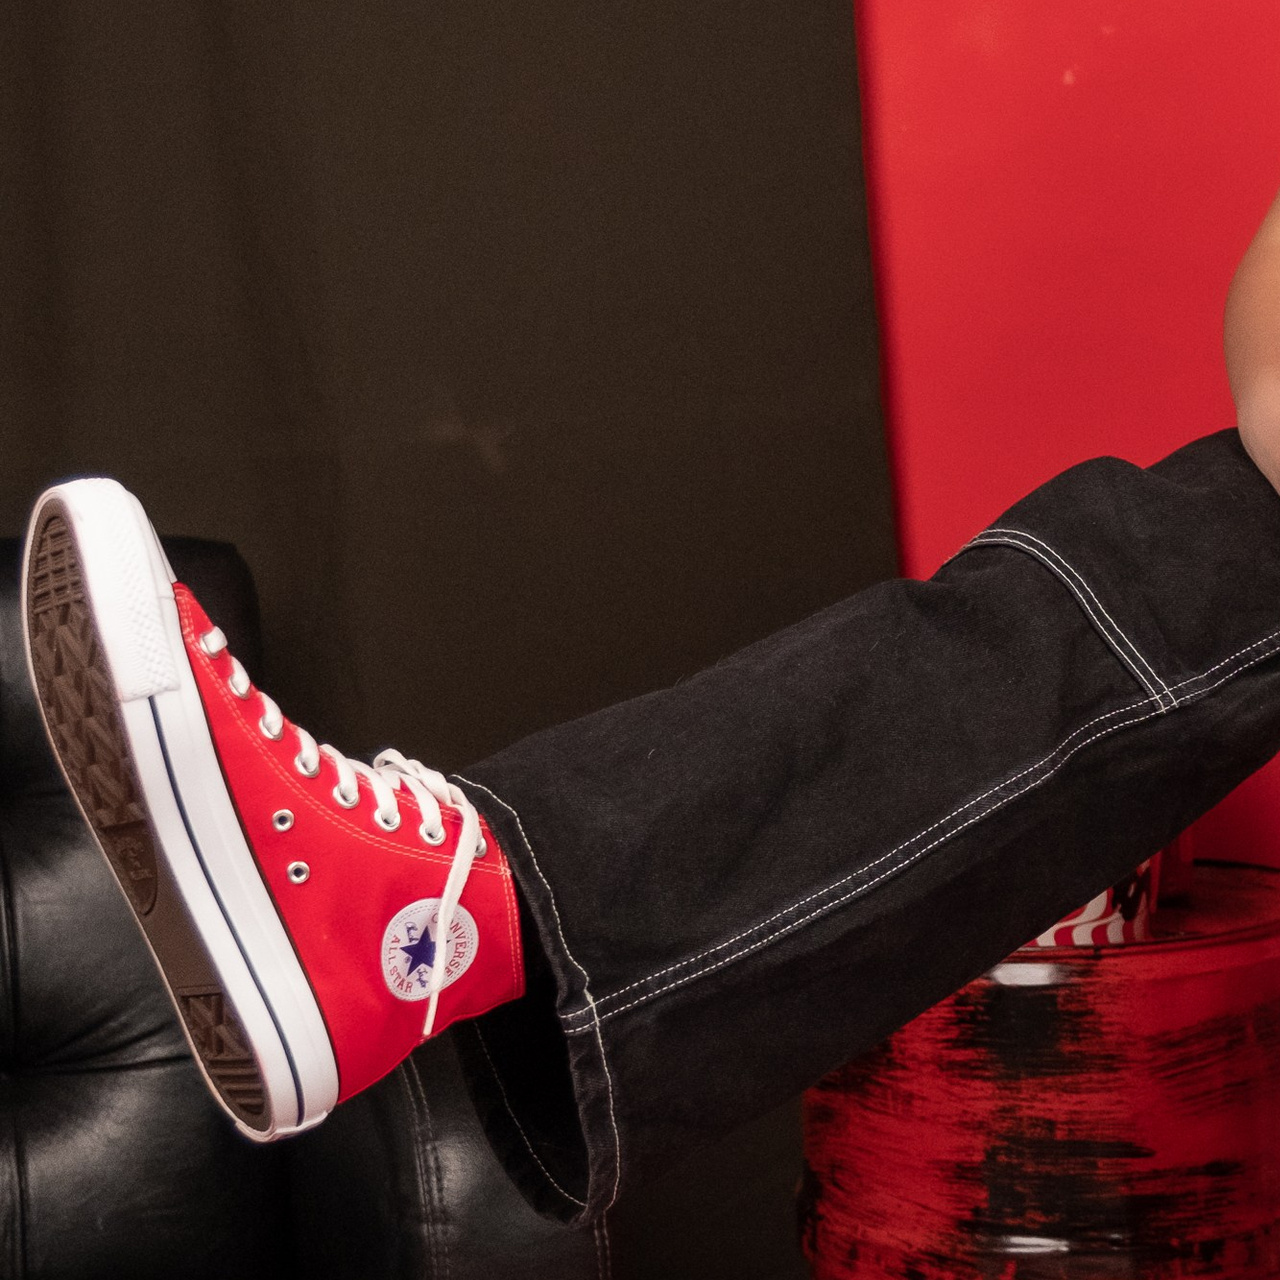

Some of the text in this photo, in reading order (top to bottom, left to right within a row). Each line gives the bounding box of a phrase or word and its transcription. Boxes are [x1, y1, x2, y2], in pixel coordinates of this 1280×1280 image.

[388, 935, 414, 993] ALL STAR
[431, 912, 467, 977] CNVERSE
